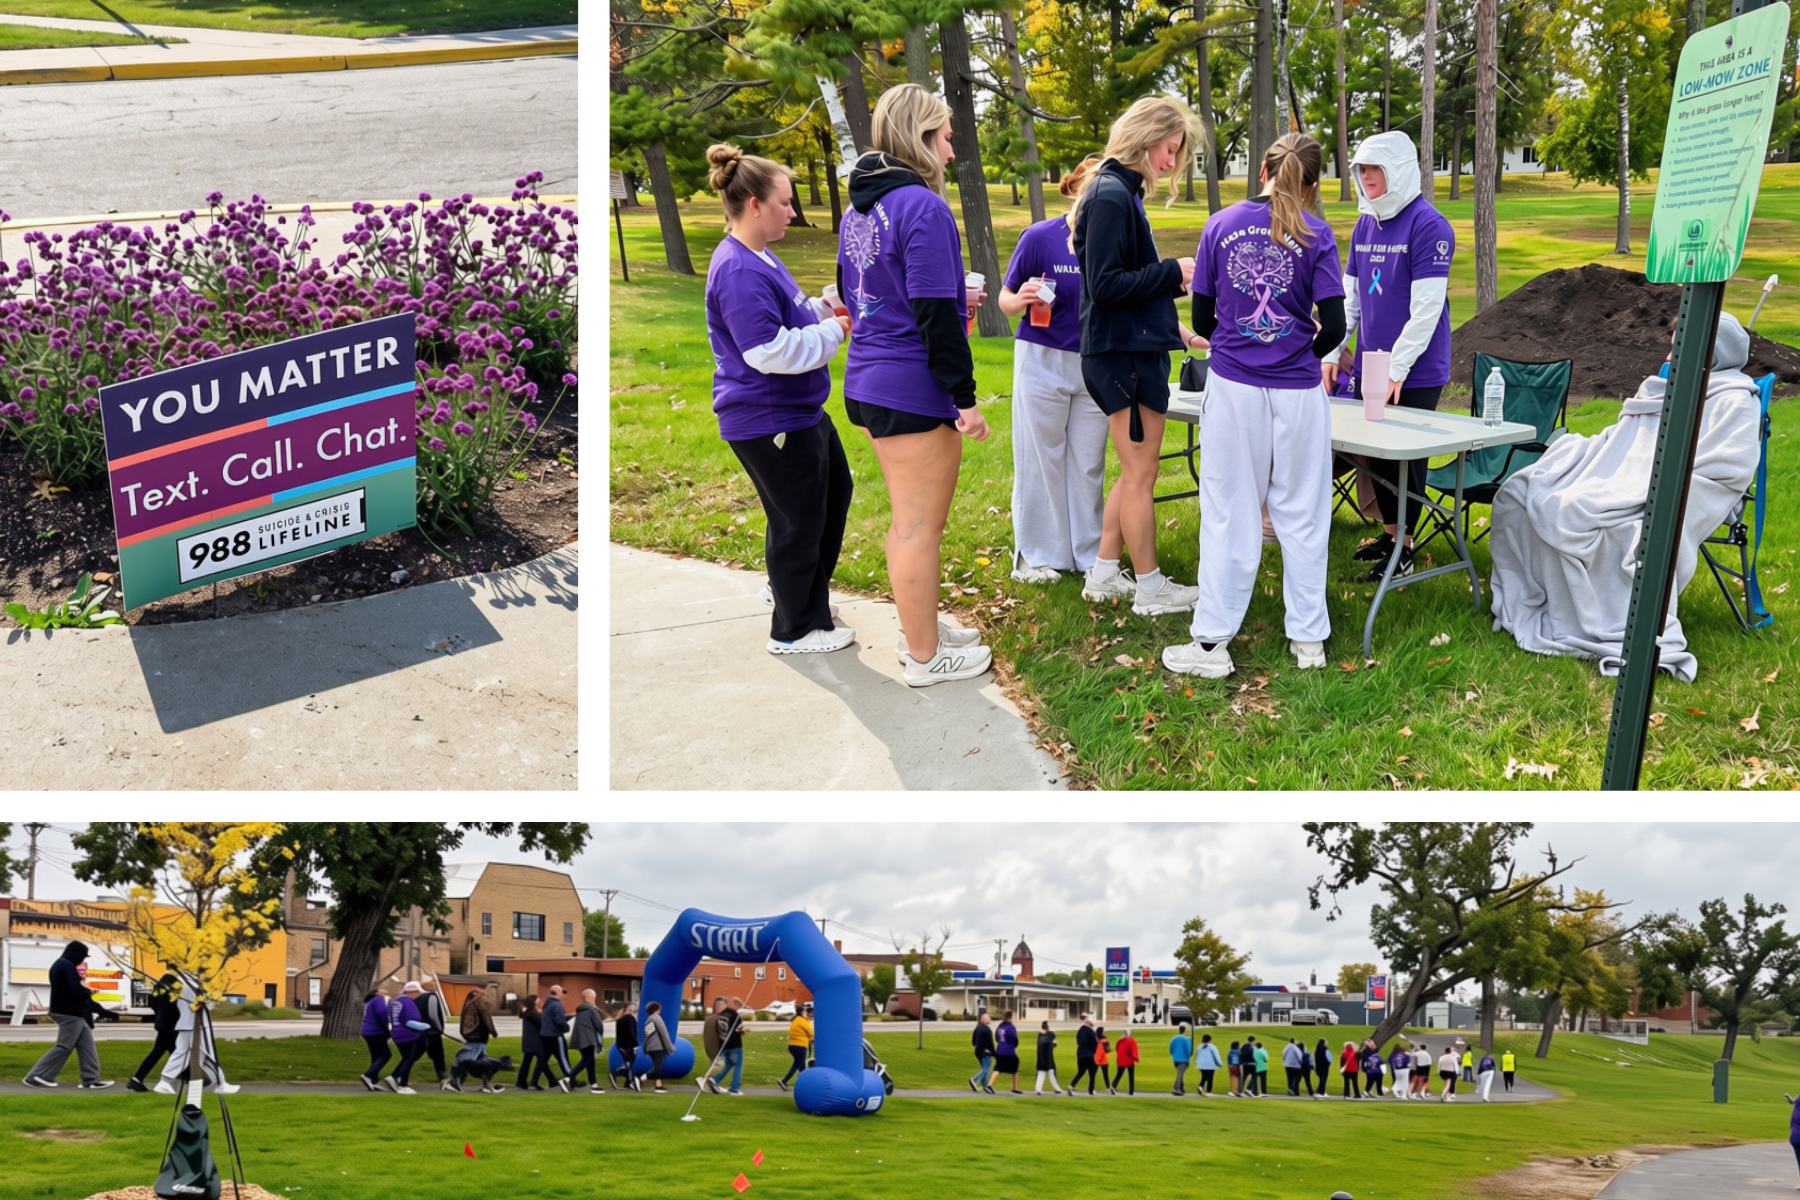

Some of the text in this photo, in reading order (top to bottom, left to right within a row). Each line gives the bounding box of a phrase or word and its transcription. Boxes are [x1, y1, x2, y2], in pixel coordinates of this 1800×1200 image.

[1747, 46, 1752, 57] A
[1737, 57, 1771, 80] ZONE
[1053, 263, 1081, 274] WALK
[119, 336, 400, 433] YOU MATTER
[120, 417, 407, 517] Text. Call. Chat.
[314, 501, 350, 519] CRISIS
[259, 513, 351, 550] LIFELINE
[189, 530, 252, 570] 988
[690, 921, 765, 954] START
